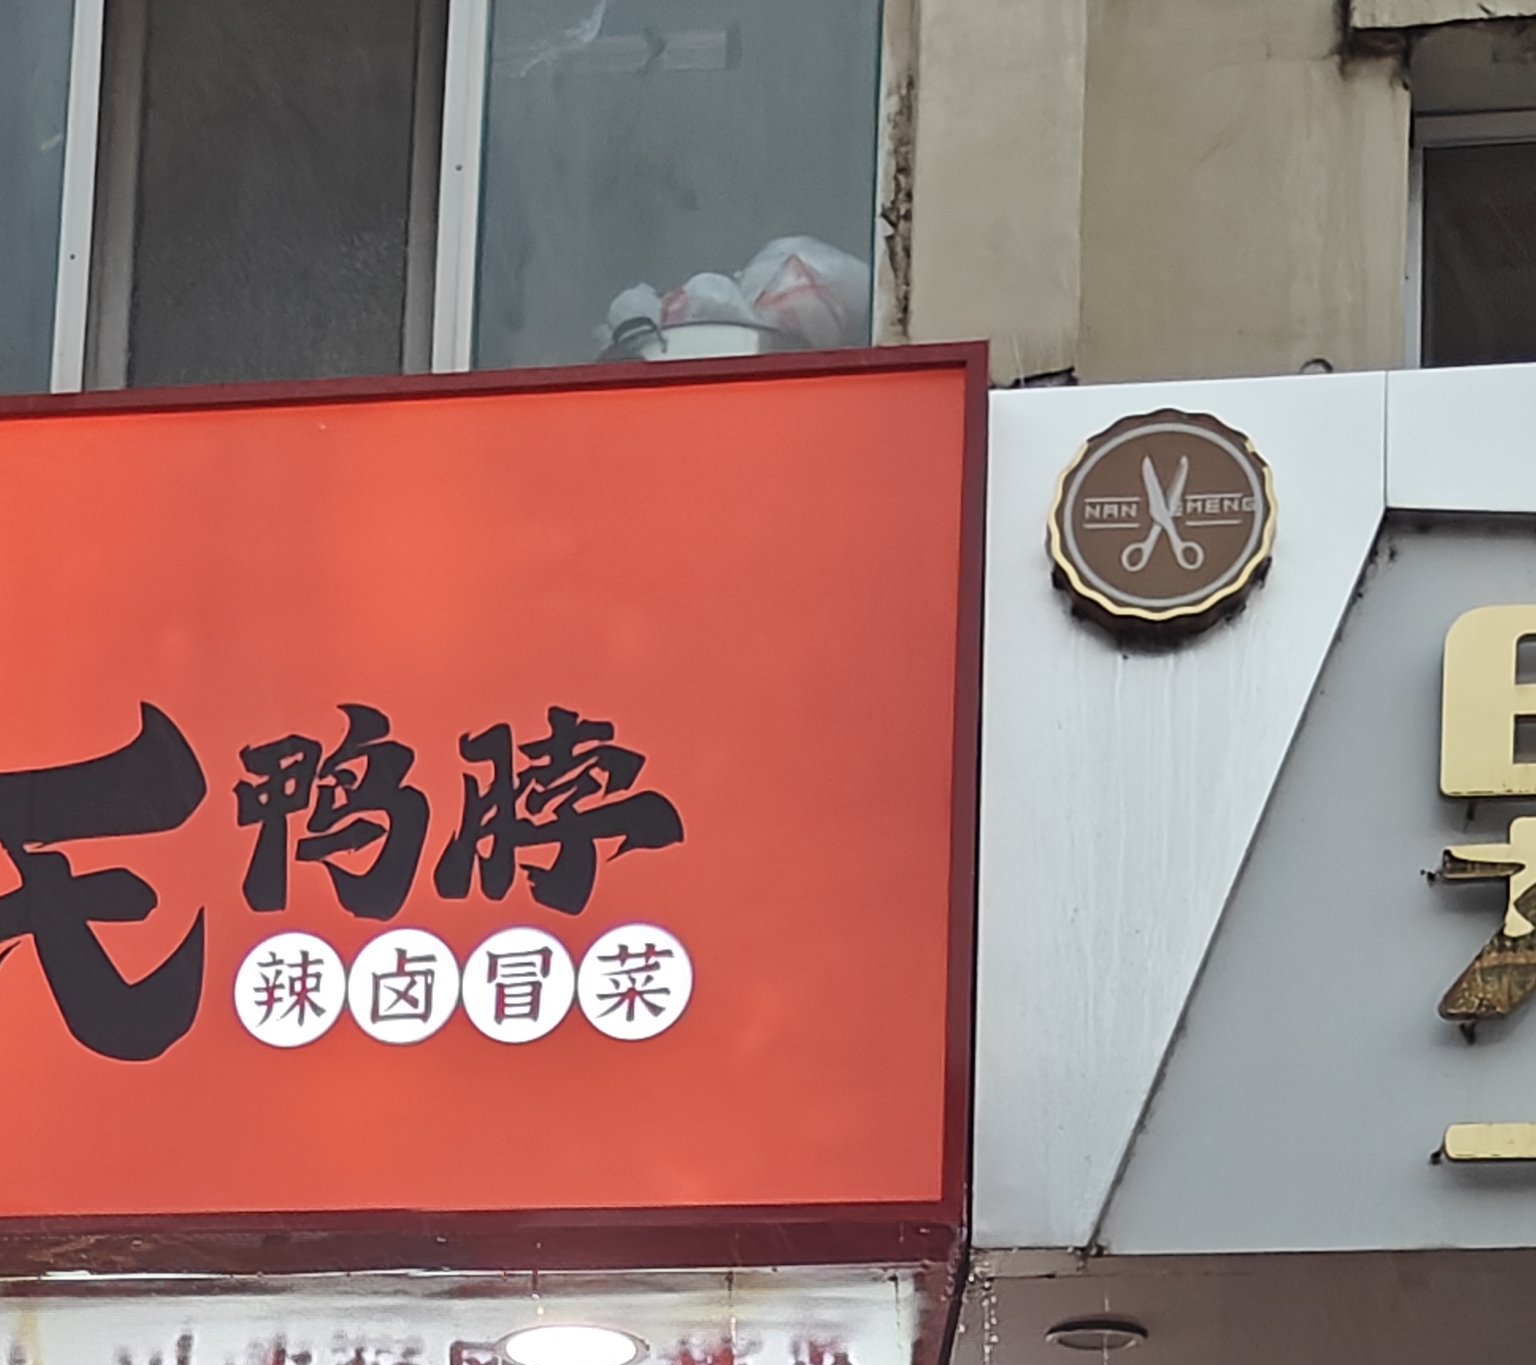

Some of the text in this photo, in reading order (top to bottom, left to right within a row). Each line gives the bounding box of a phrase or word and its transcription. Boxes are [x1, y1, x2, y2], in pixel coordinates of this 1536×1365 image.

[1084, 502, 1138, 520] NAN
[233, 704, 684, 921] 鸭脖
[250, 943, 676, 1030] 辣卤冒菜
